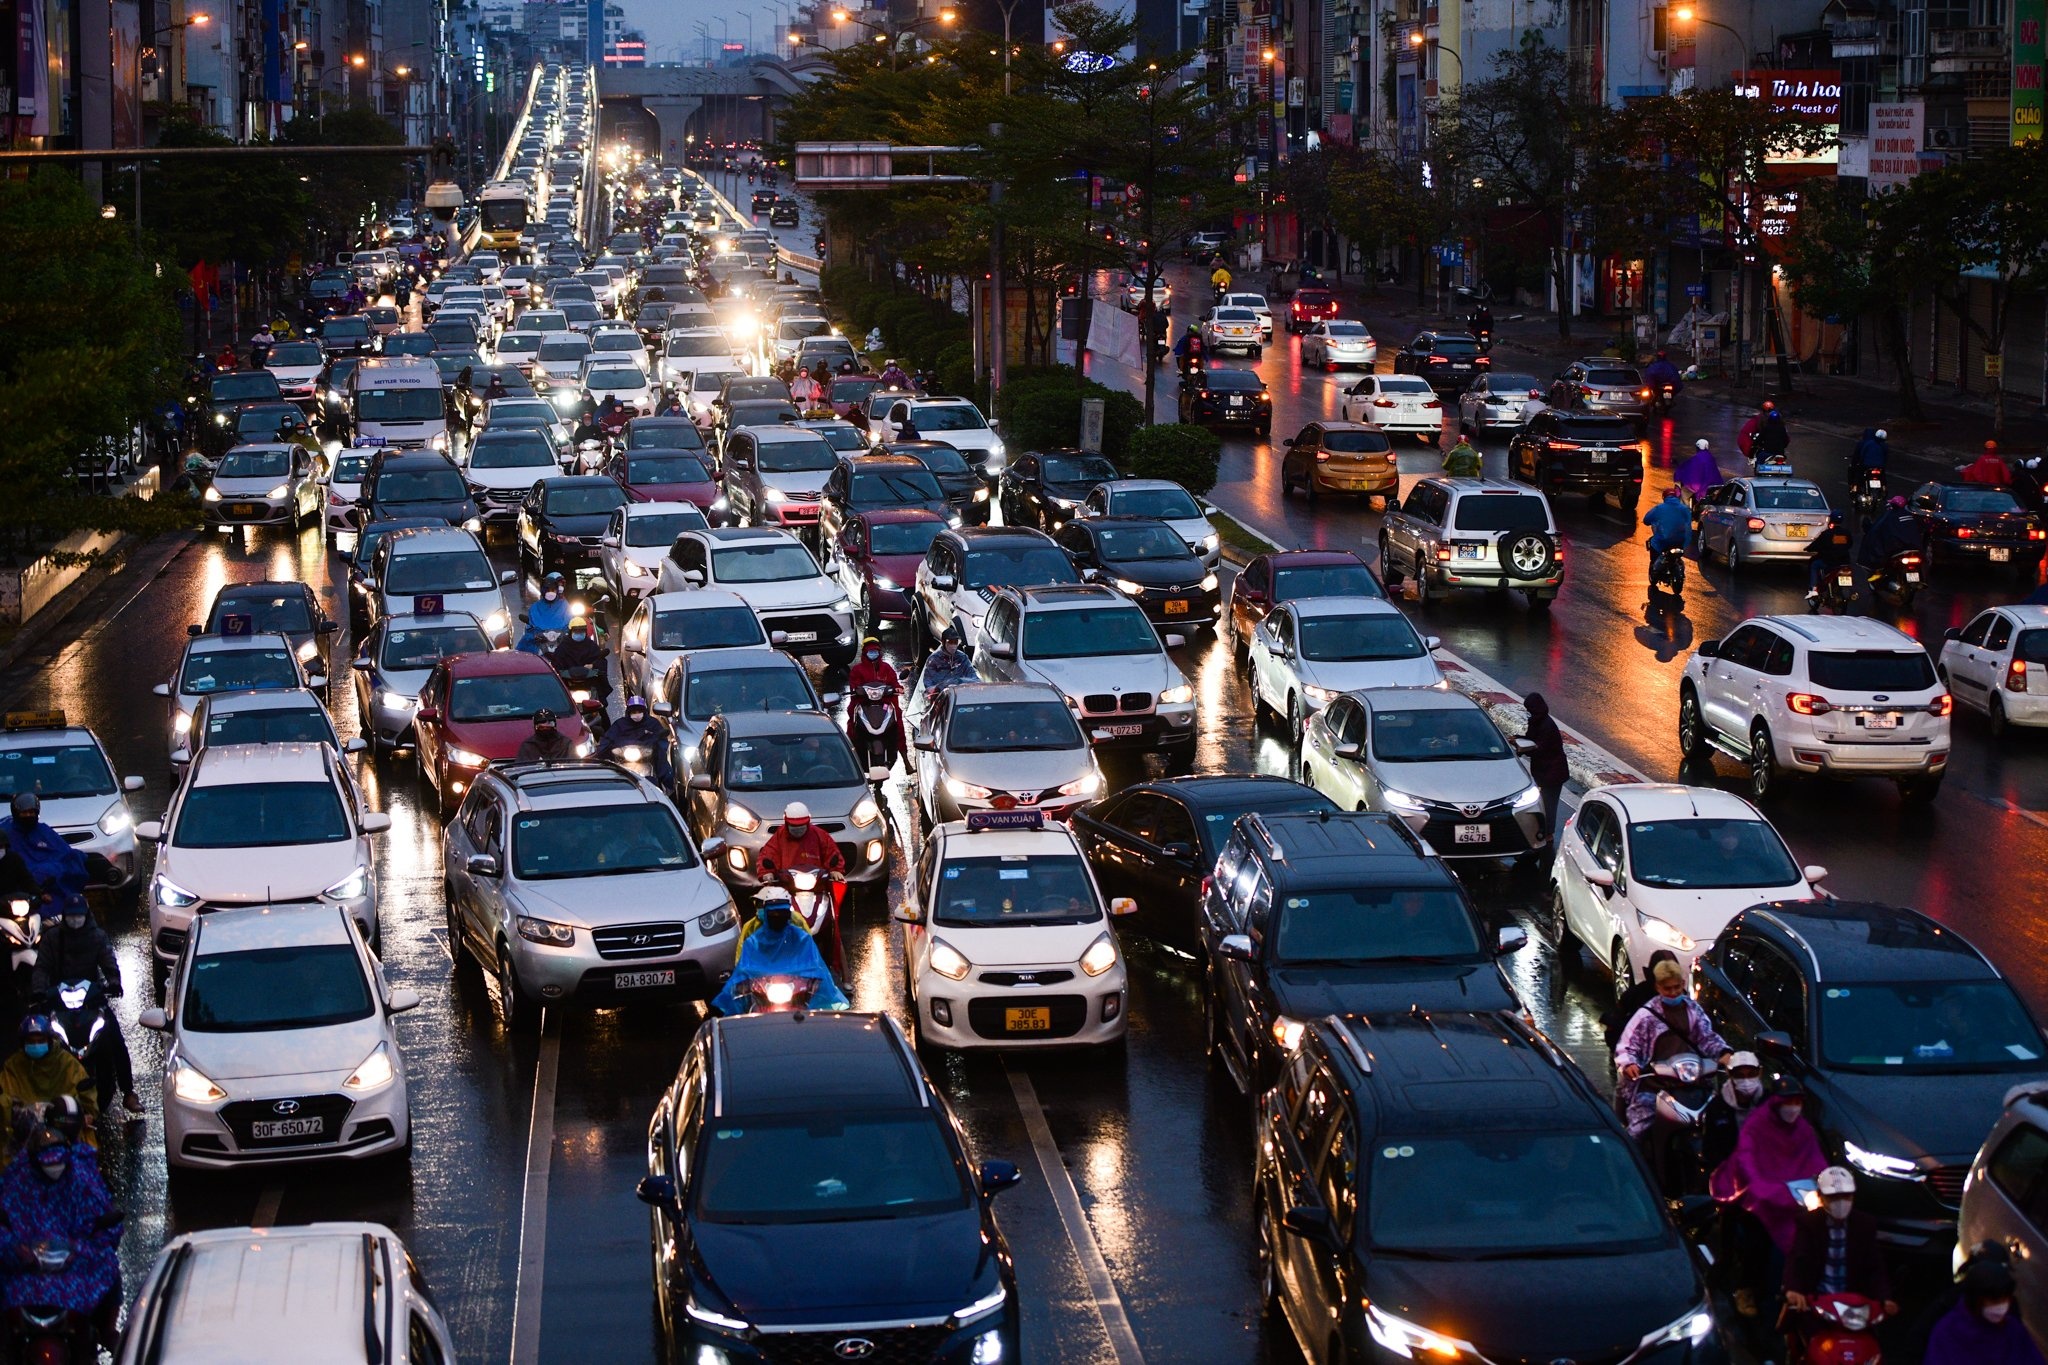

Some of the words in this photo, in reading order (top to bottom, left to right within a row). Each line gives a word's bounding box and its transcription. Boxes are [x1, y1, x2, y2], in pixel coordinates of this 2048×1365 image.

[1772, 80, 1808, 97] Tinh
[1825, 104, 1838, 114] of
[2014, 102, 2041, 125] CHÁO
[1875, 136, 1886, 153] MÁY
[1887, 138, 1899, 153] BƠM
[1900, 136, 1915, 153] NƯỚC
[421, 597, 436, 612] G7
[228, 617, 244, 633] G7
[992, 816, 1010, 826] VẠN
[1011, 814, 1035, 823] XUÂN
[1465, 826, 1480, 834] 99A
[1459, 834, 1486, 842] 494.76
[617, 972, 674, 988] 29A-830.73
[1018, 1009, 1037, 1019] 30E
[1010, 1020, 1046, 1029] 385.83
[254, 1120, 321, 1137] 30F-650.72
